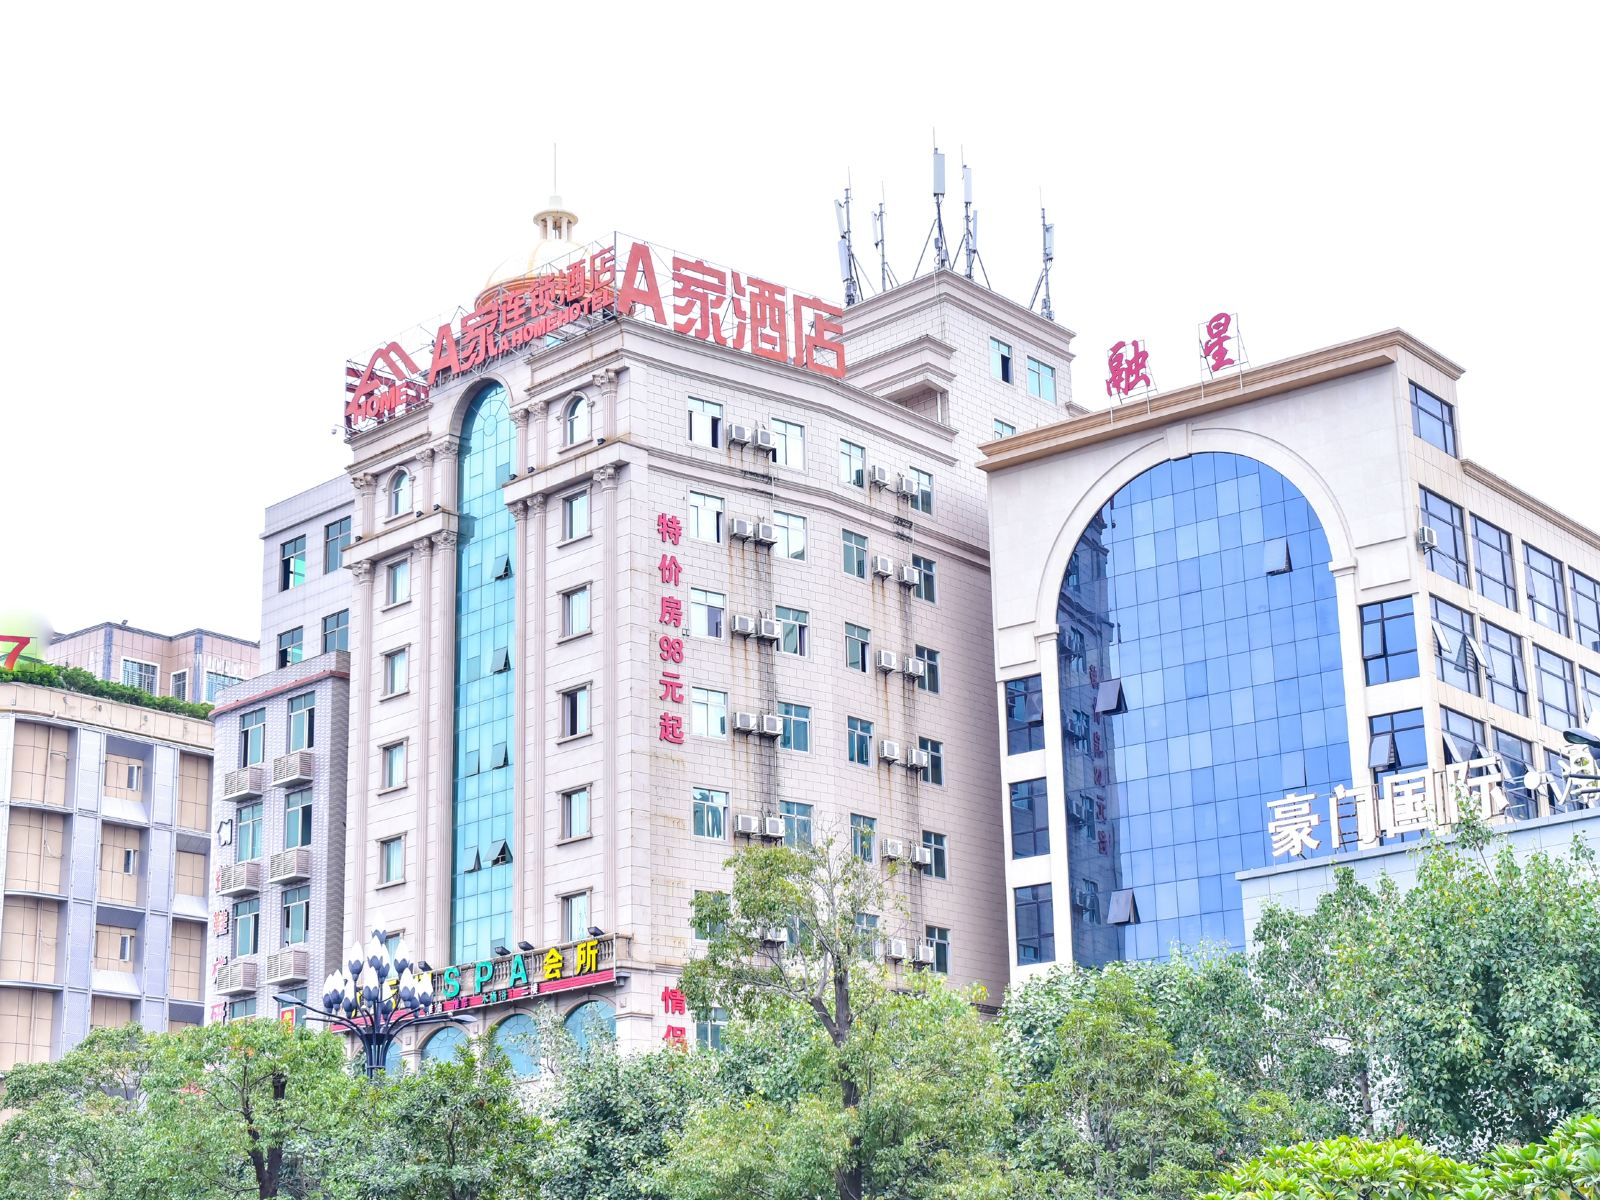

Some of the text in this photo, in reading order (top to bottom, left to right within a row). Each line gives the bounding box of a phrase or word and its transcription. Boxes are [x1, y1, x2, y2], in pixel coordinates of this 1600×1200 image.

[618, 241, 845, 379] A家酒店
[657, 512, 685, 745] 特价房98元起
